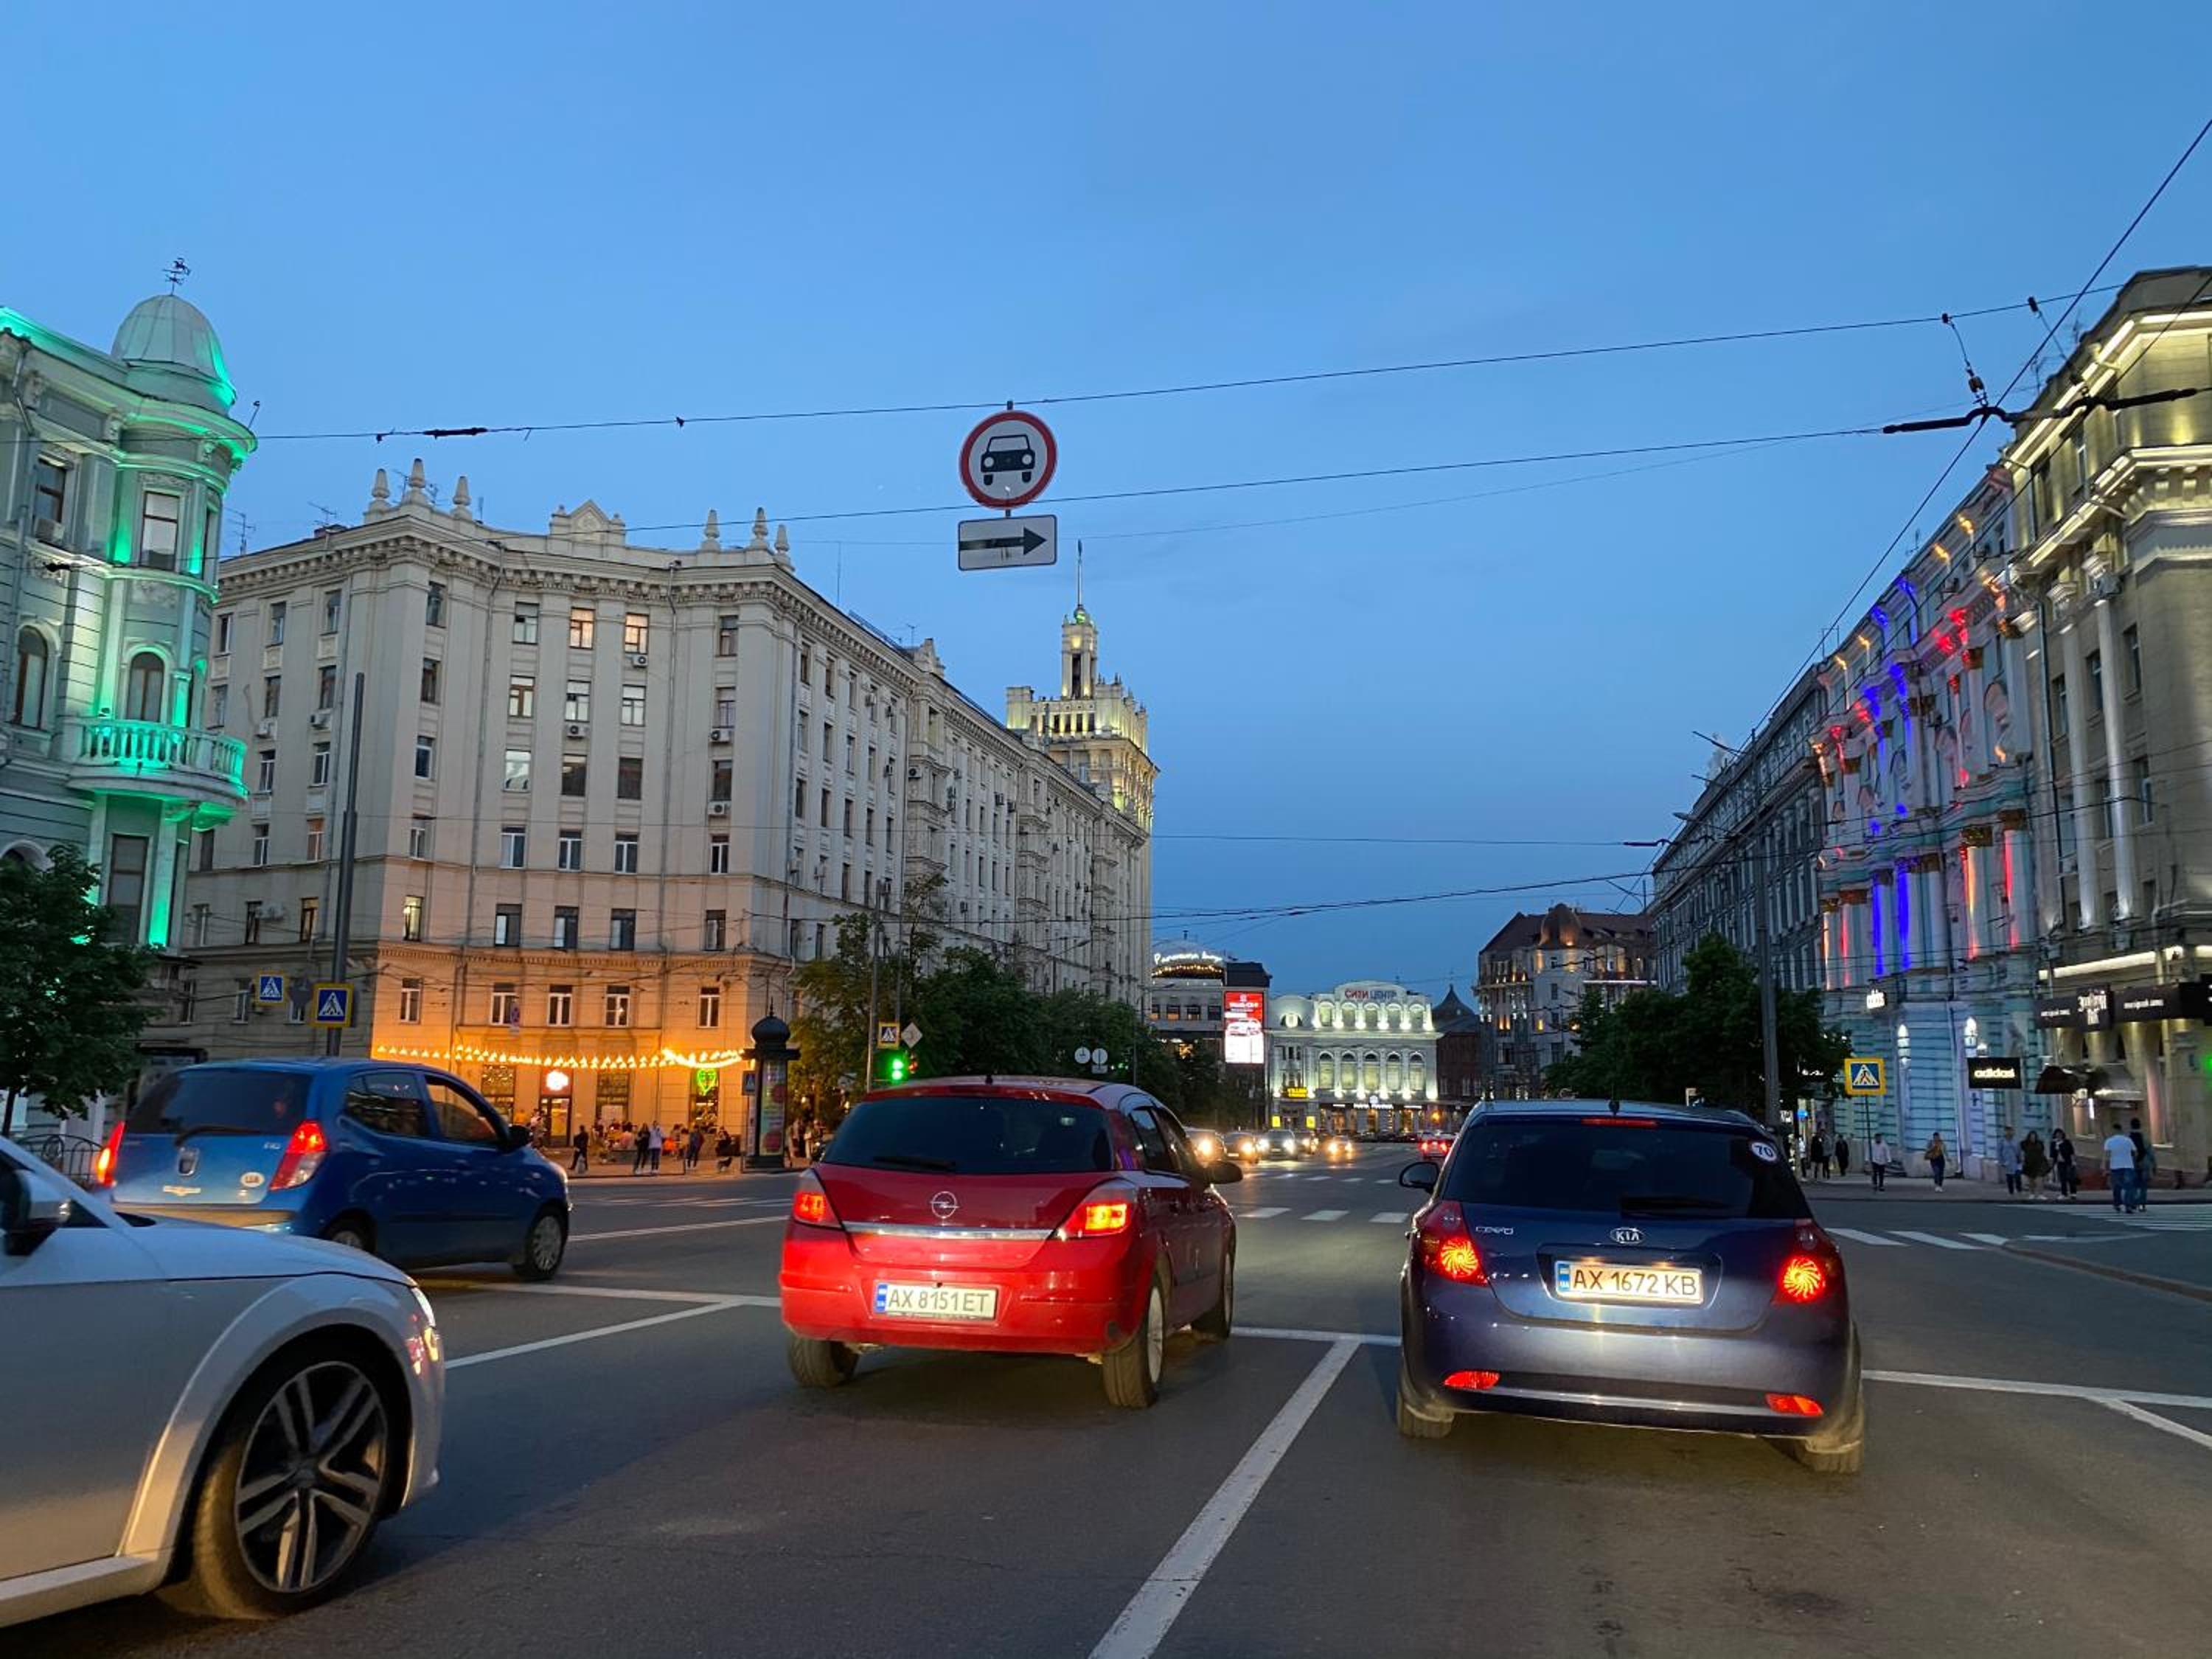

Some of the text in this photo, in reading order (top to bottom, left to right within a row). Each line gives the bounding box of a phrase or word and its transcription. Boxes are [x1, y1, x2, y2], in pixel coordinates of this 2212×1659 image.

[1754, 1145, 1773, 1158] 70
[1615, 1231, 1639, 1242] KIA
[1573, 1269, 1696, 1295] AX 1672 KB
[888, 1289, 990, 1312] AX 8151 ET
